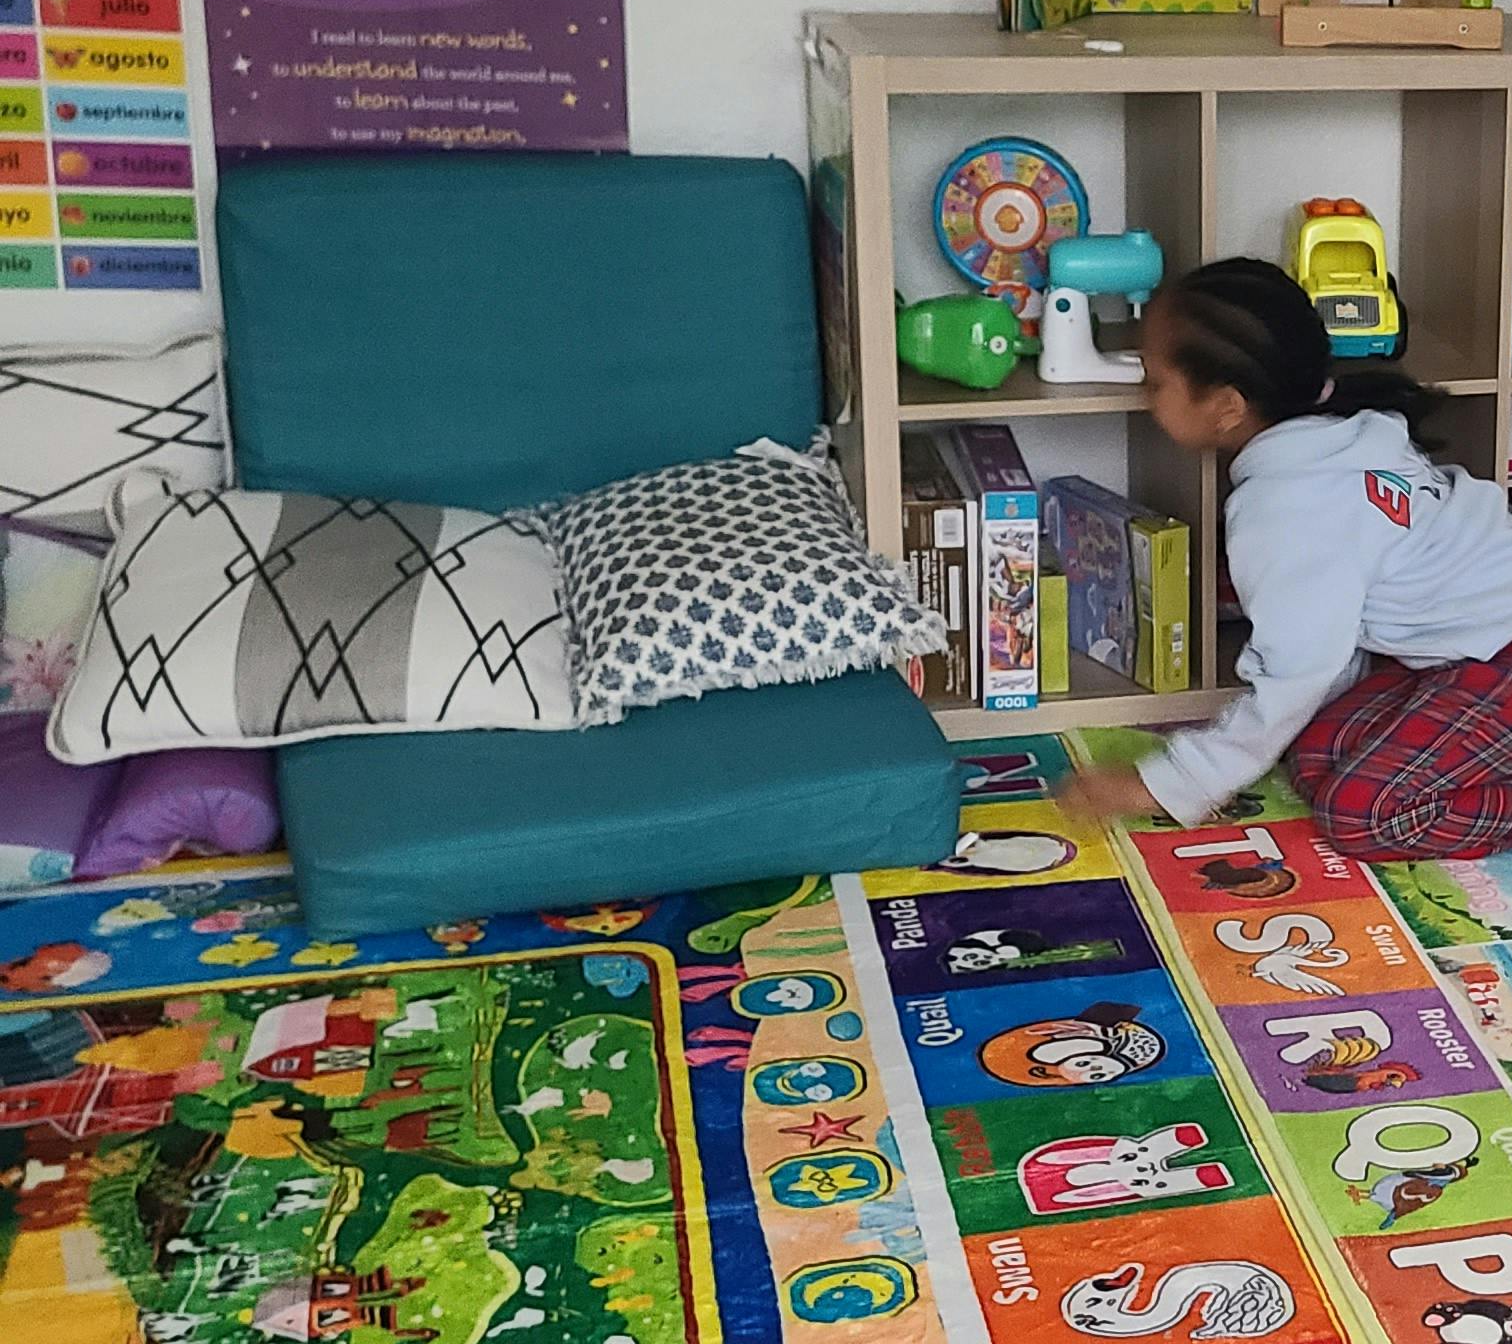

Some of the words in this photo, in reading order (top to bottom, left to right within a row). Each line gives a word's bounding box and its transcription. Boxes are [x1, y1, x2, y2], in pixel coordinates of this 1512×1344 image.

[419, 33, 463, 48] new
[89, 49, 169, 72] agosto
[294, 56, 418, 80] understand
[82, 102, 186, 123] septiembre
[354, 87, 408, 110] learn
[93, 156, 182, 176] octubre
[91, 207, 193, 225] noviembre
[99, 255, 193, 274] diciembre
[994, 697, 1028, 708] 1000
[1173, 825, 1286, 862] T
[880, 896, 928, 952] Panda
[1213, 912, 1336, 955] S
[1364, 922, 1408, 968] Swan
[904, 996, 966, 1048] Quail
[1264, 1008, 1393, 1066] R
[1416, 1006, 1478, 1074] Rooster
[942, 1106, 997, 1178] Rabbit
[1331, 1103, 1482, 1184] Q
[986, 1235, 1039, 1307] Swan
